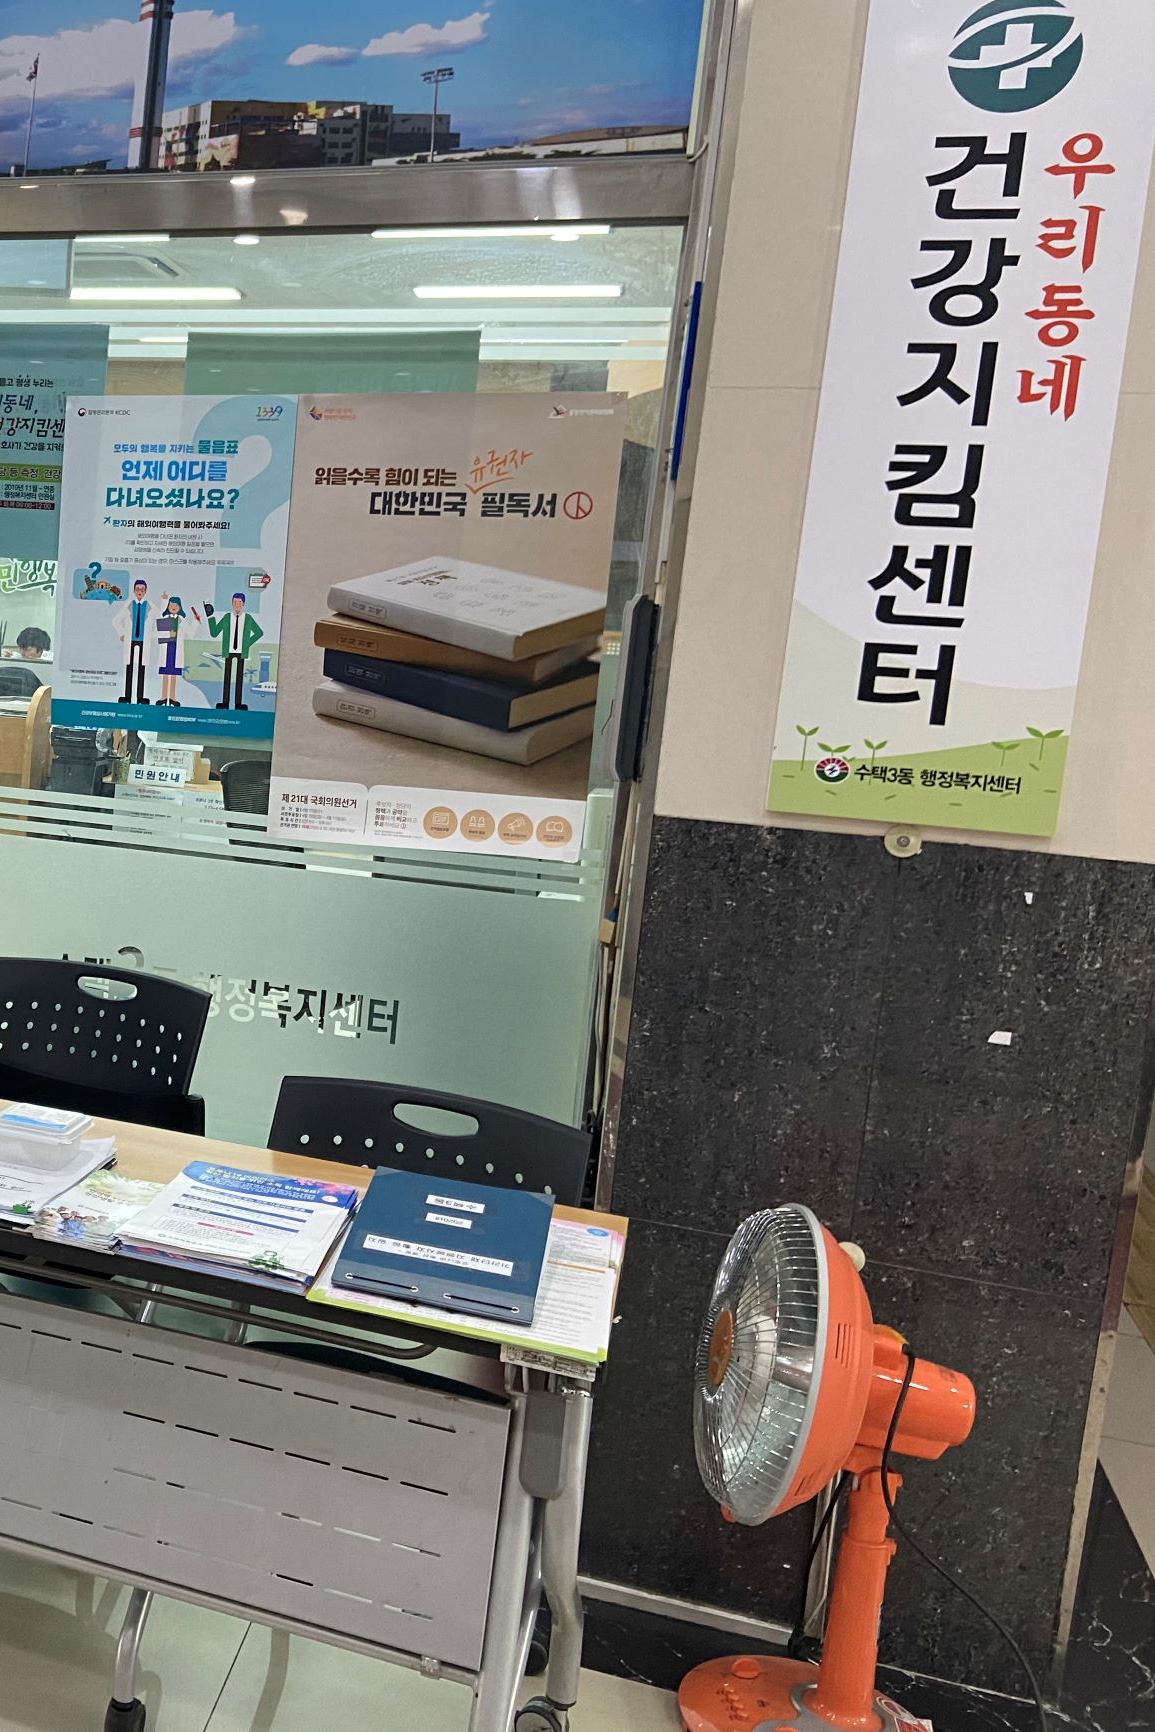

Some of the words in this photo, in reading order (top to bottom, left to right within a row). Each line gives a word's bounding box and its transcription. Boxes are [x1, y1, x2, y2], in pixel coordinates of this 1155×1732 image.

[1015, 130, 1117, 423] 우리동네
[33, 378, 54, 388] 누리는
[255, 405, 283, 418] 1339
[857, 130, 1028, 728] 건강지킴센터
[24, 442, 45, 451] 건강을
[113, 444, 138, 453] 모두의
[140, 443, 166, 454] 행복을
[169, 443, 194, 454] 지키는
[197, 440, 239, 455] 물음표
[121, 459, 164, 481] 언제
[167, 460, 228, 482] 어디를
[469, 448, 534, 484] 유권자
[314, 467, 381, 486] 읽을수록
[384, 468, 418, 487] 힘이
[422, 468, 457, 487] 되는
[105, 487, 240, 510] 다녀오셨나요?
[369, 490, 467, 517] 대한민국
[480, 491, 558, 519] 필독서
[112, 519, 135, 528] 환자의
[137, 519, 181, 529] 해외여행력을
[183, 520, 231, 530] 물어봐주세요!
[134, 769, 180, 783] 민원안내
[854, 764, 915, 786] 수택3동
[919, 768, 1022, 794] 행정복지센터
[281, 793, 290, 803] 제
[291, 794, 309, 805] 21대
[310, 795, 358, 809] 국회의원선거
[434, 1216, 464, 1226] 2020년
